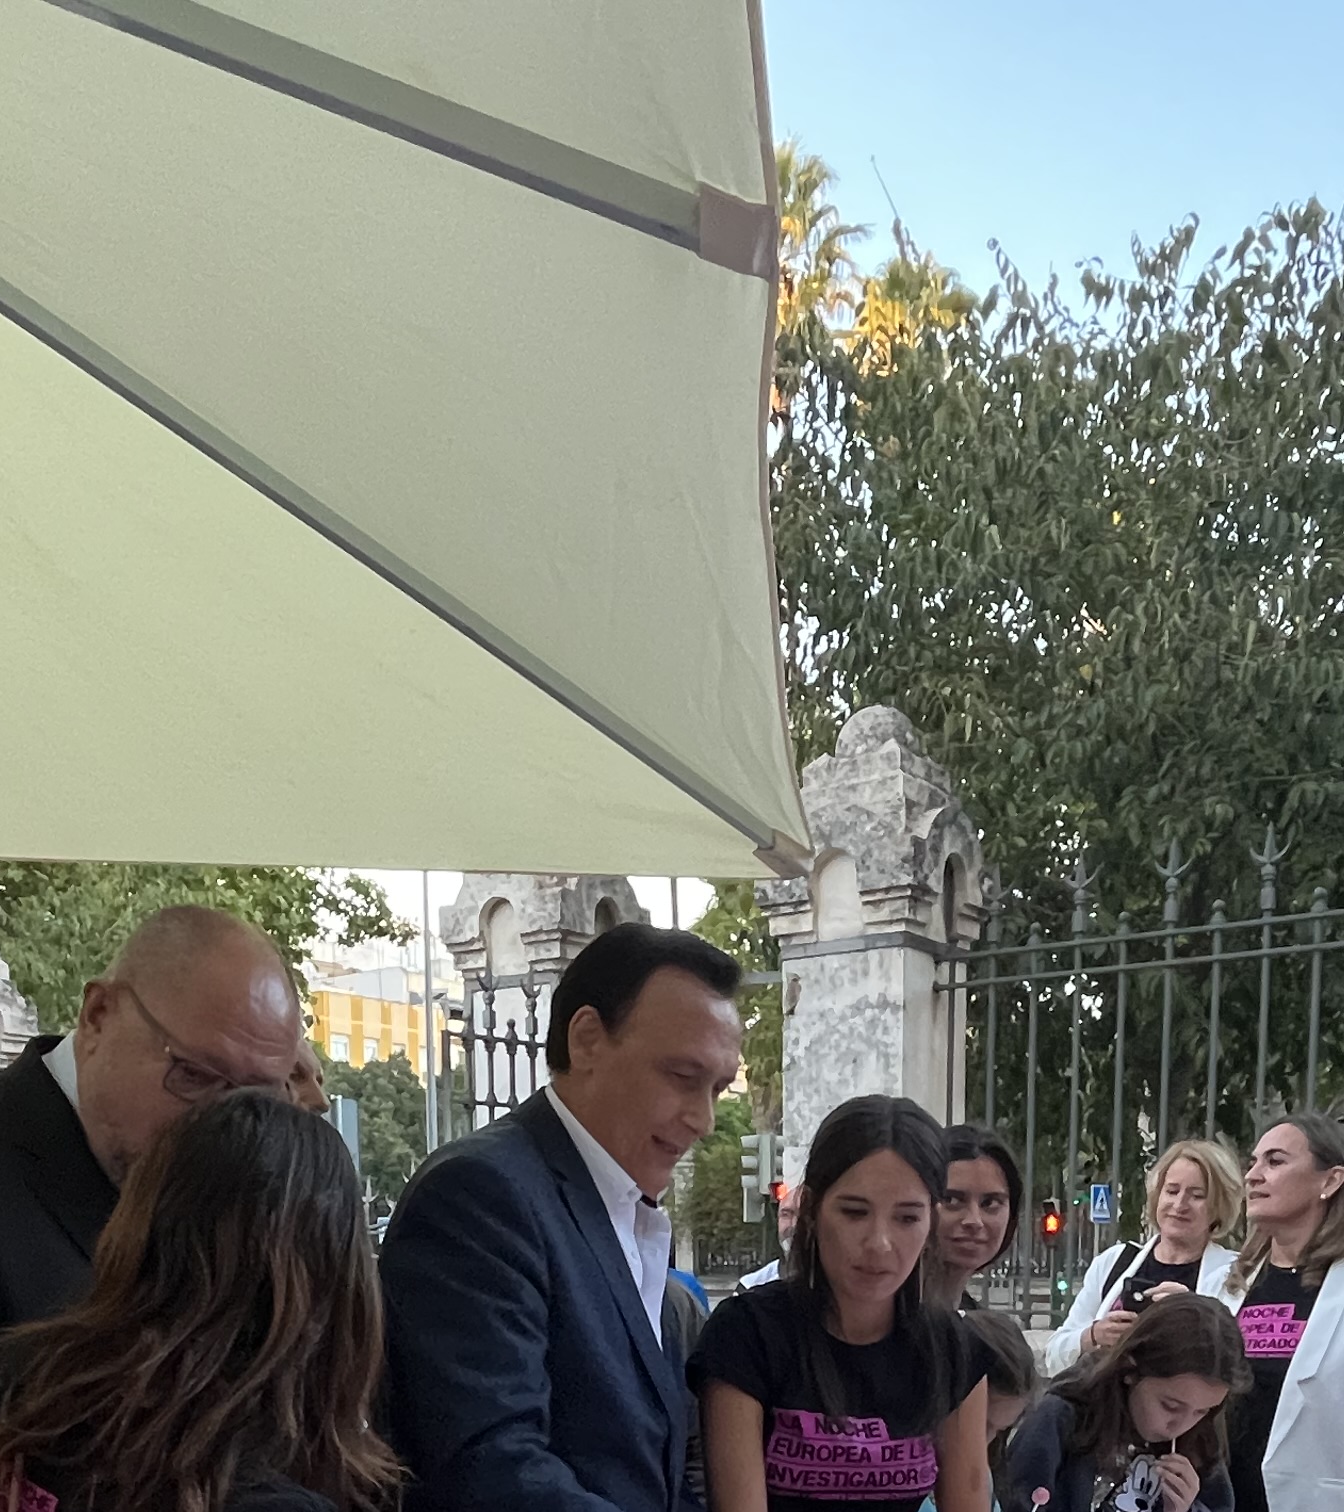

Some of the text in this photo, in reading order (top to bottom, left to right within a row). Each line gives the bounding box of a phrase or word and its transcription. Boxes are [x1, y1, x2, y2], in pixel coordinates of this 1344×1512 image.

[1242, 1306, 1291, 1320] NOCHE
[1240, 1322, 1300, 1334] OPEA DE
[777, 1412, 804, 1431] LA
[772, 1436, 872, 1463] EUROPEA
[881, 1443, 905, 1463] DE
